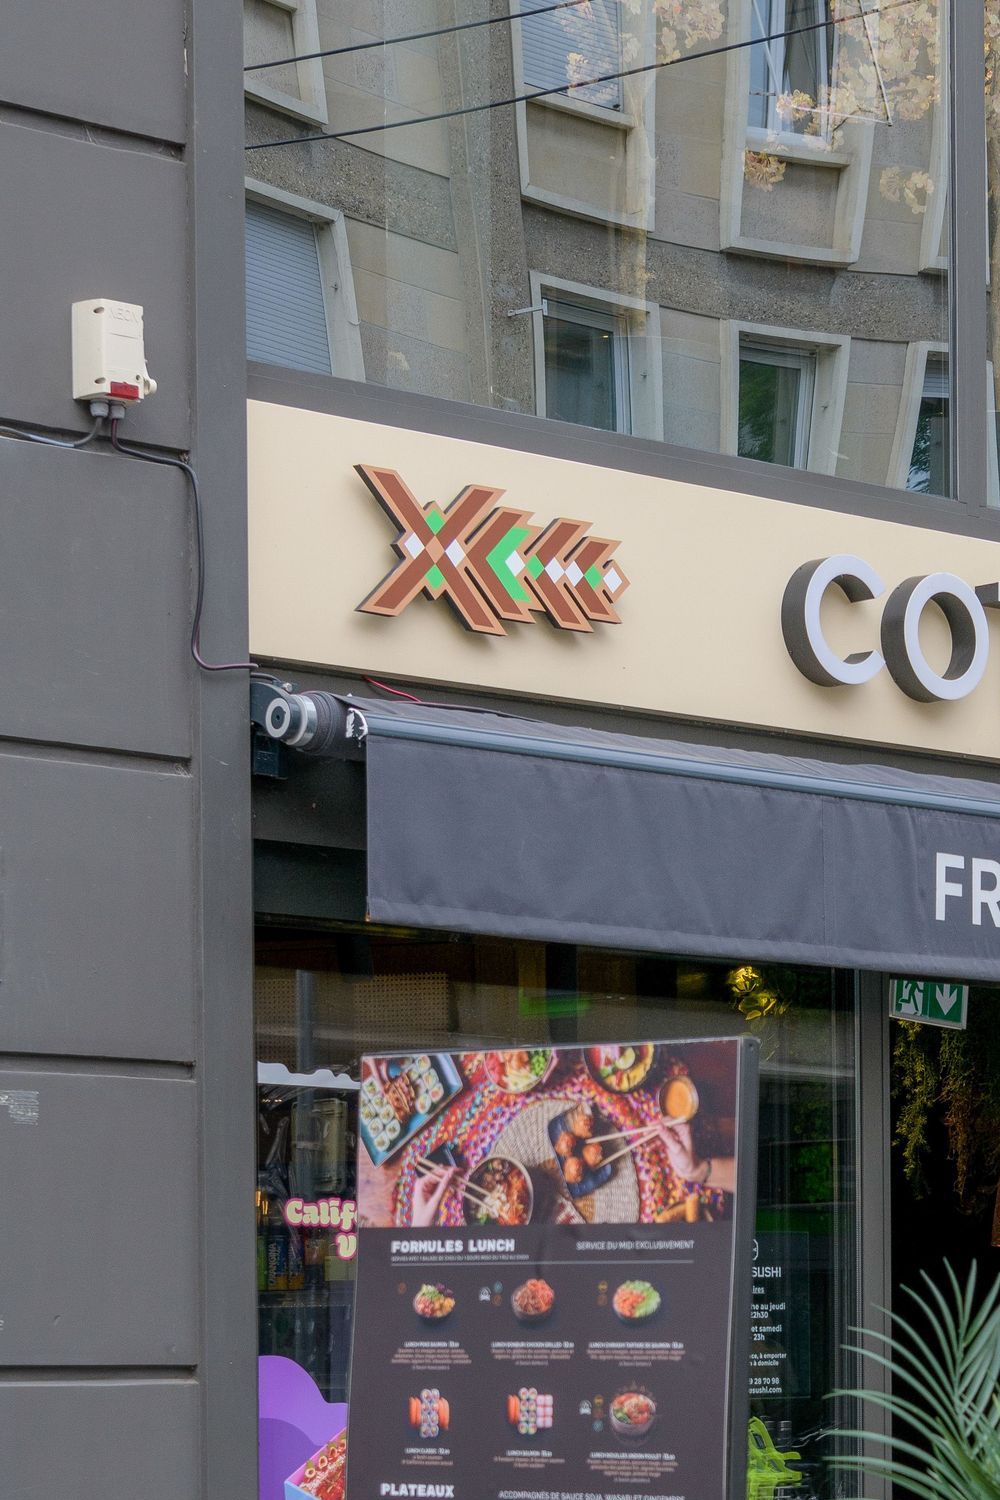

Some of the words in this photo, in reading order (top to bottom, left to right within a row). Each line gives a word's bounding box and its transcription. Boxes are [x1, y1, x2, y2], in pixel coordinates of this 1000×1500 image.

[286, 1197, 357, 1231] Calif
[390, 1240, 464, 1254] FORMULES
[468, 1238, 516, 1253] LUNCH
[576, 1241, 606, 1251] SERVICE
[607, 1240, 618, 1250] DU
[752, 1266, 782, 1278] SUSHI
[769, 1302, 786, 1312] jeudi
[759, 1324, 782, 1333] samedi
[380, 1482, 455, 1499] PLATEAUX
[550, 1491, 560, 1500] DE
